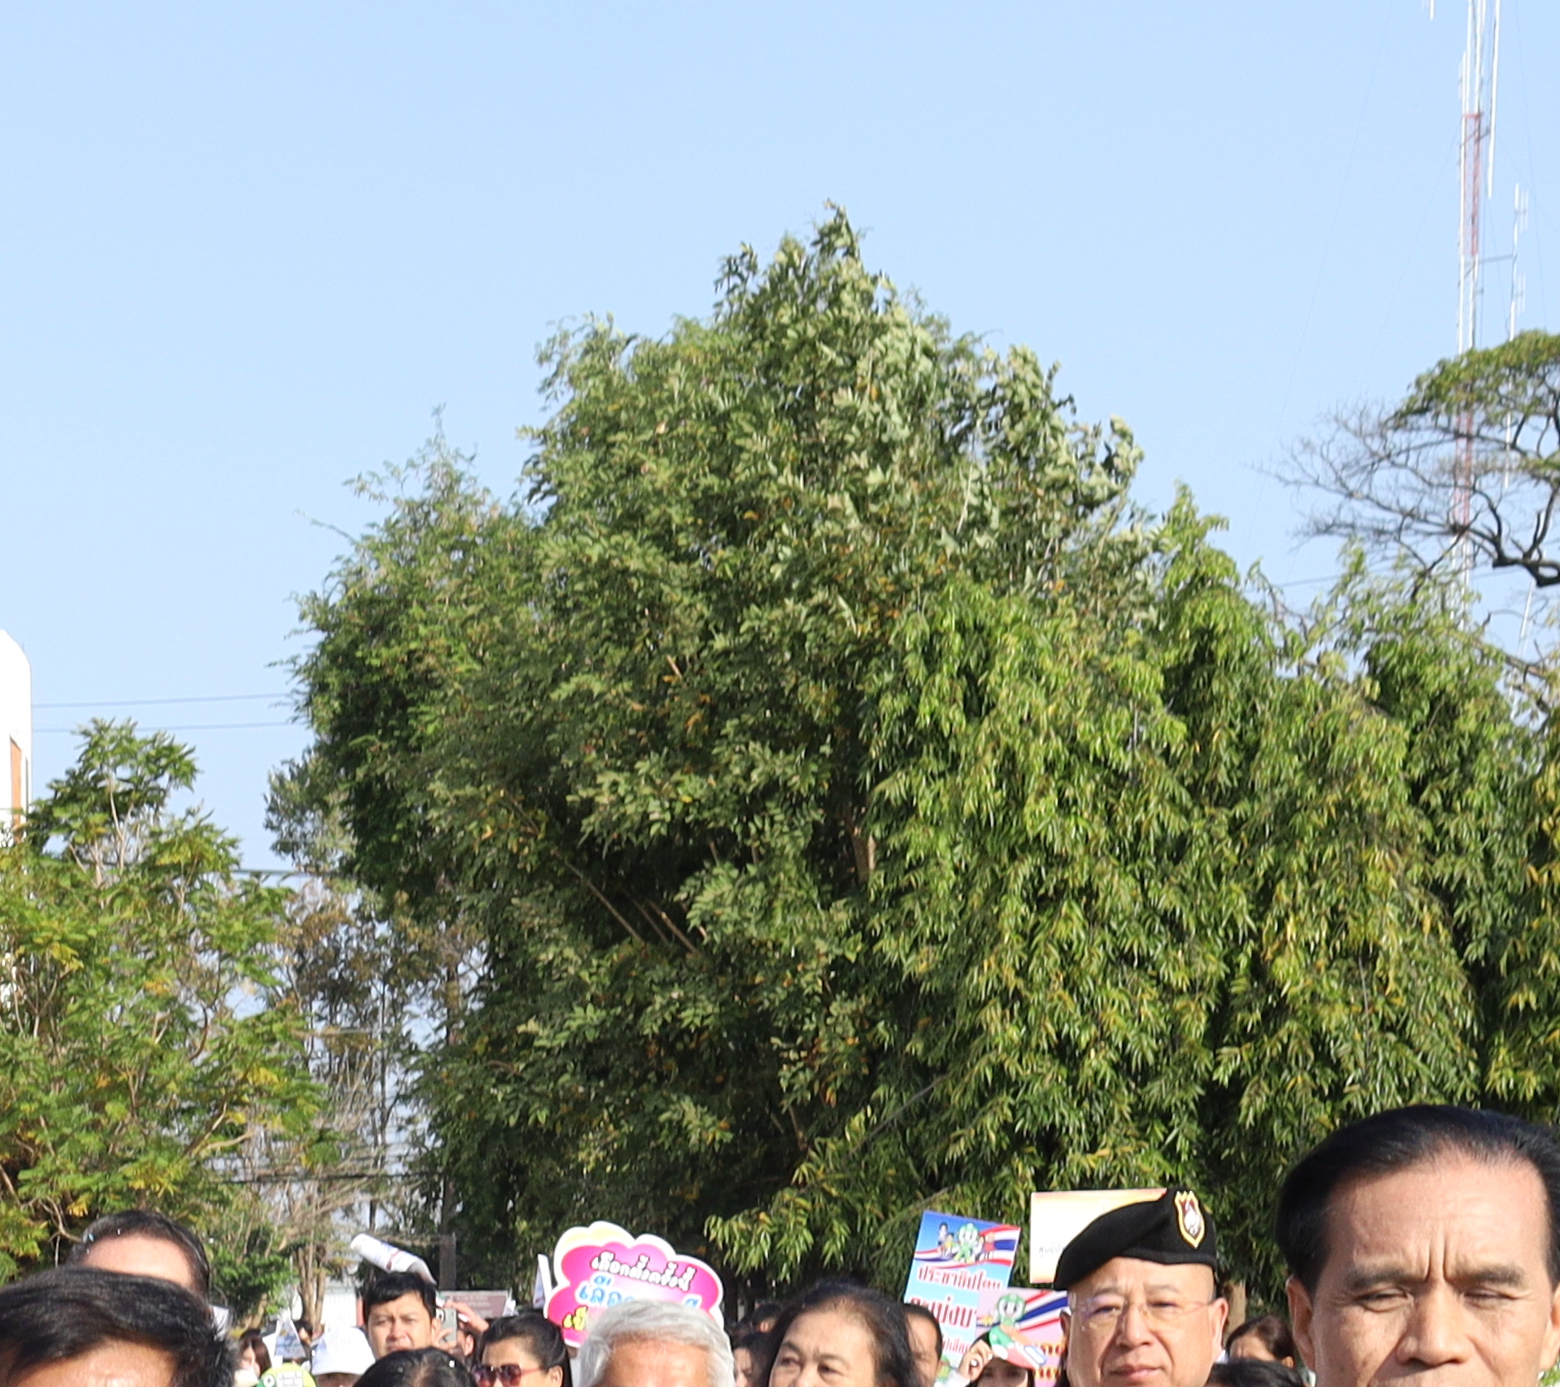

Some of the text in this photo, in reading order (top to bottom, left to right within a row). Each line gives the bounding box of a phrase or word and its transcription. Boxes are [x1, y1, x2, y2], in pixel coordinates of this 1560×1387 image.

[590, 1252, 697, 1292] เลือกตั้งครั้งนี้
